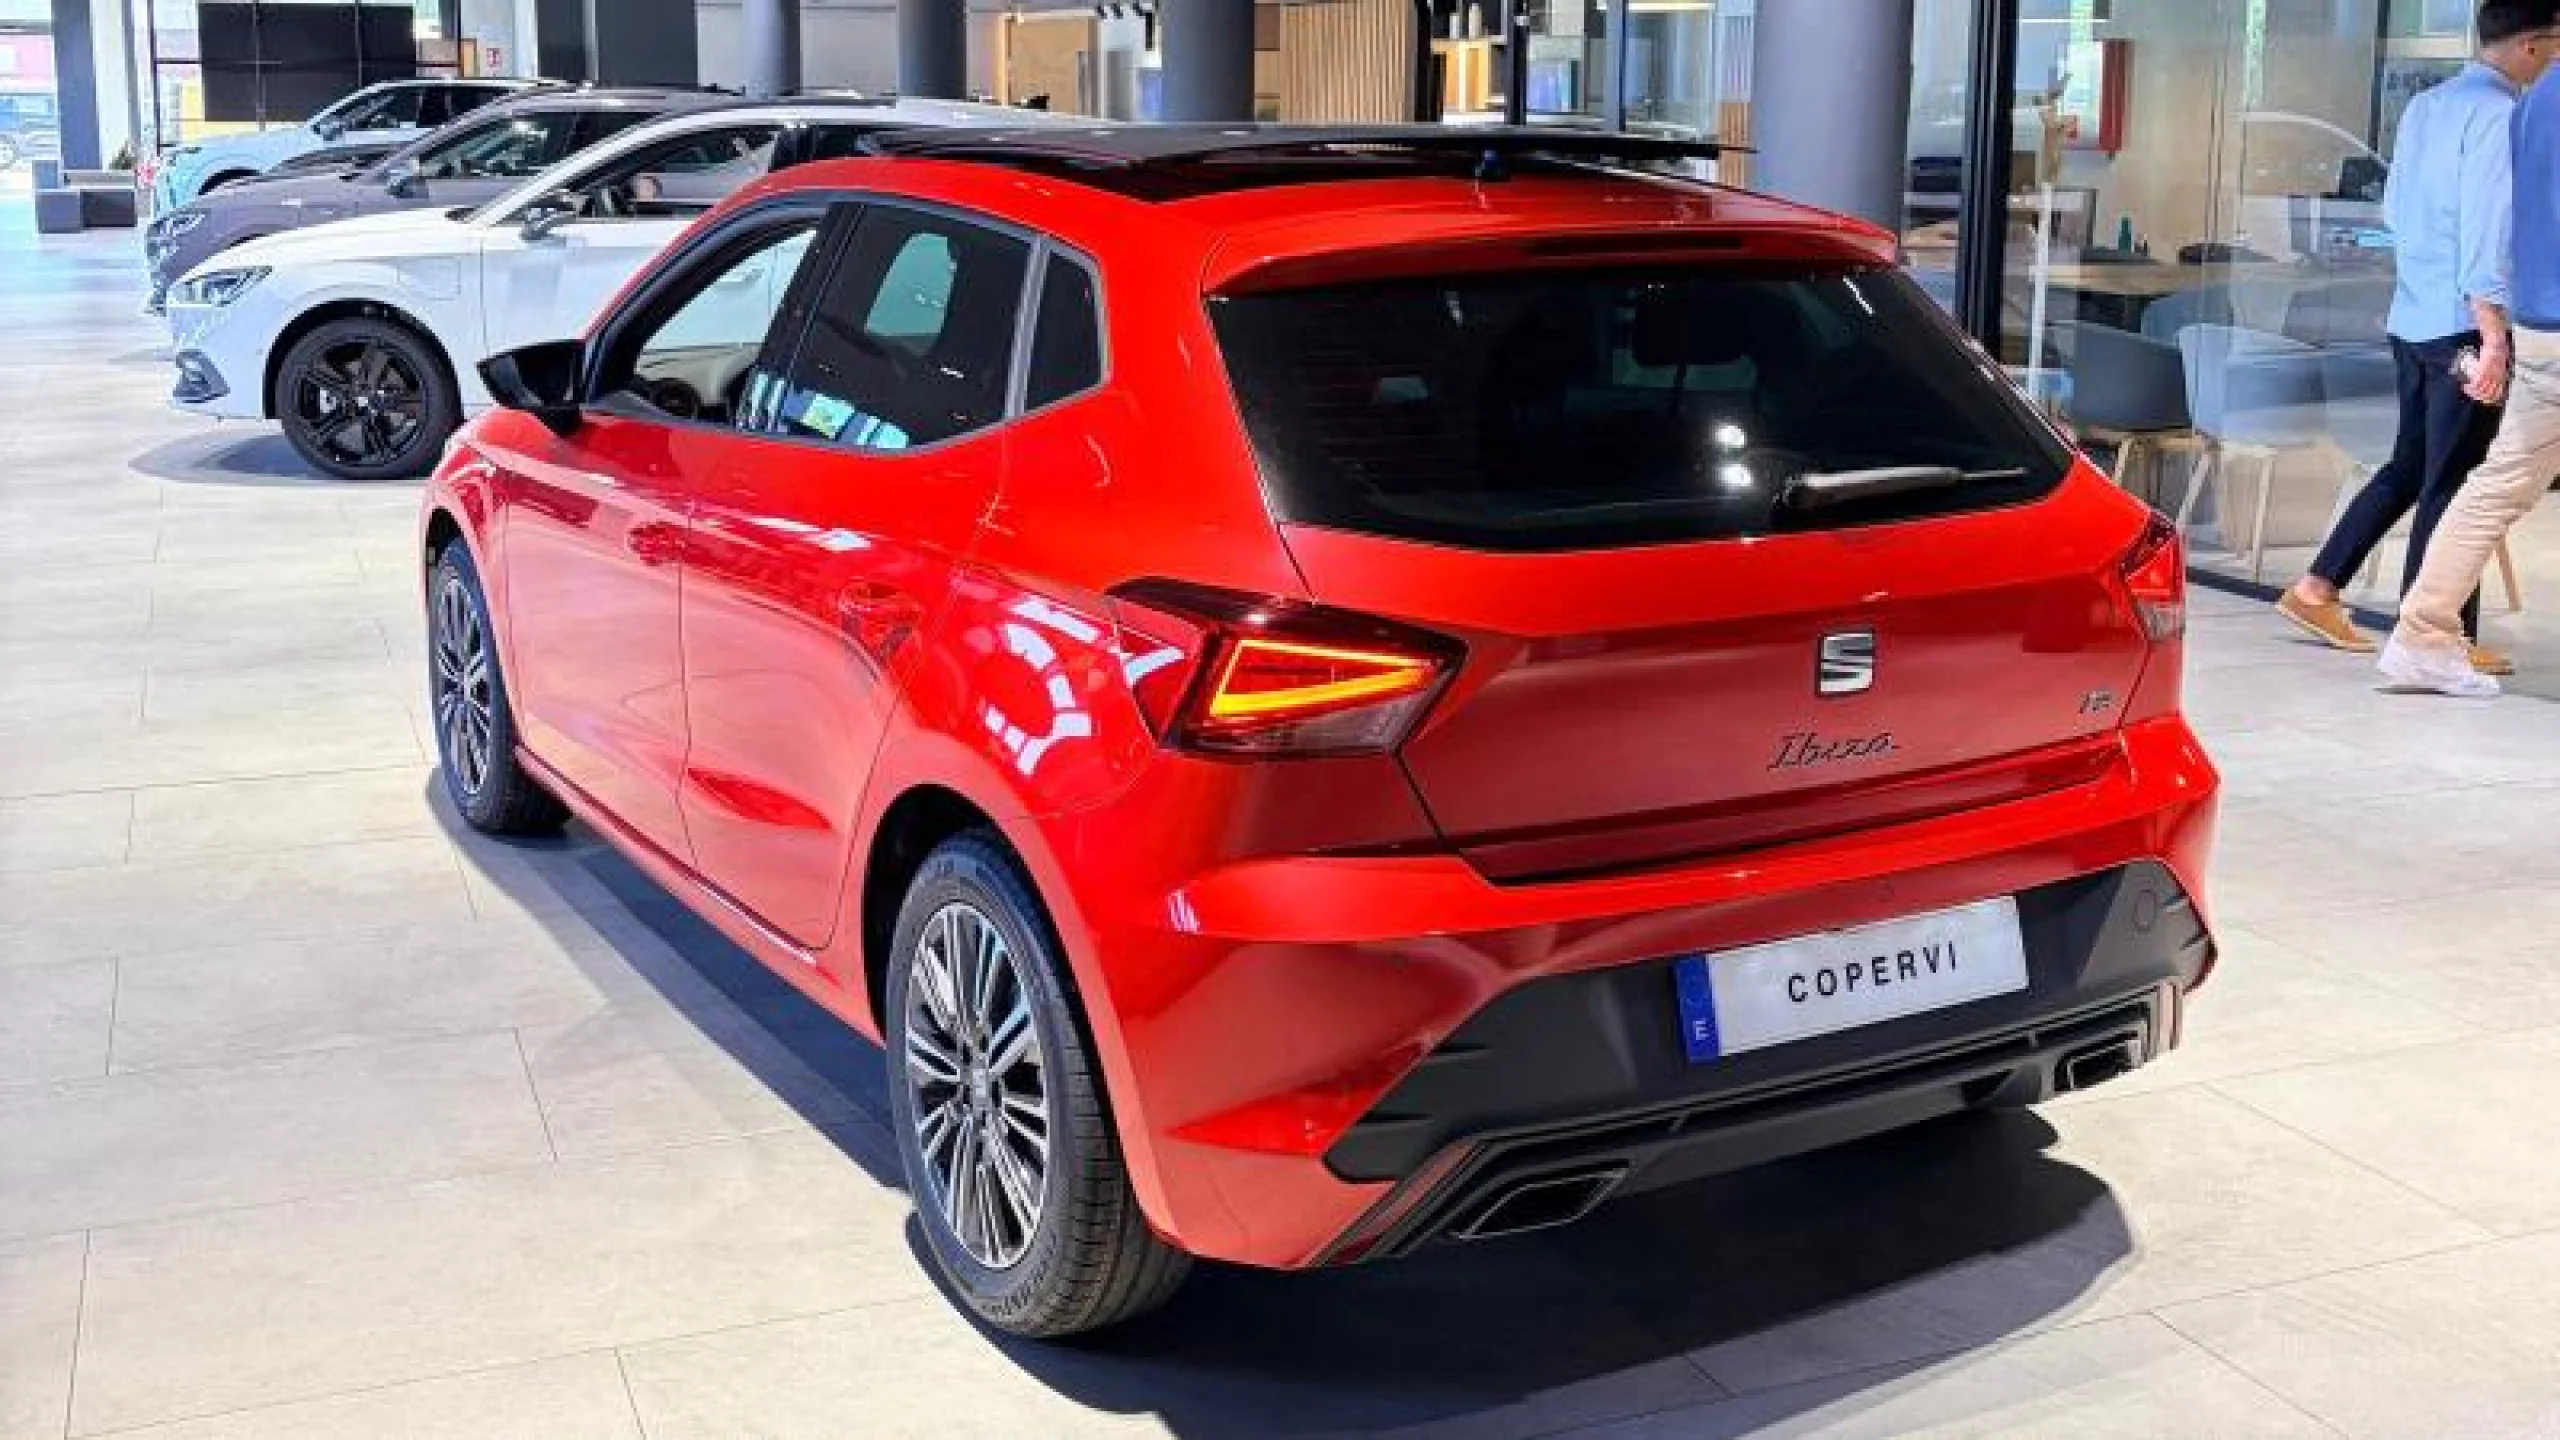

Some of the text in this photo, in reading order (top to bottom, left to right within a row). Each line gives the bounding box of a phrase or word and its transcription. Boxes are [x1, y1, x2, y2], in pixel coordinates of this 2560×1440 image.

[1766, 732, 1901, 770] Ibiza
[1788, 940, 1957, 1003] COPERVI
[1694, 1018, 1710, 1041] E
